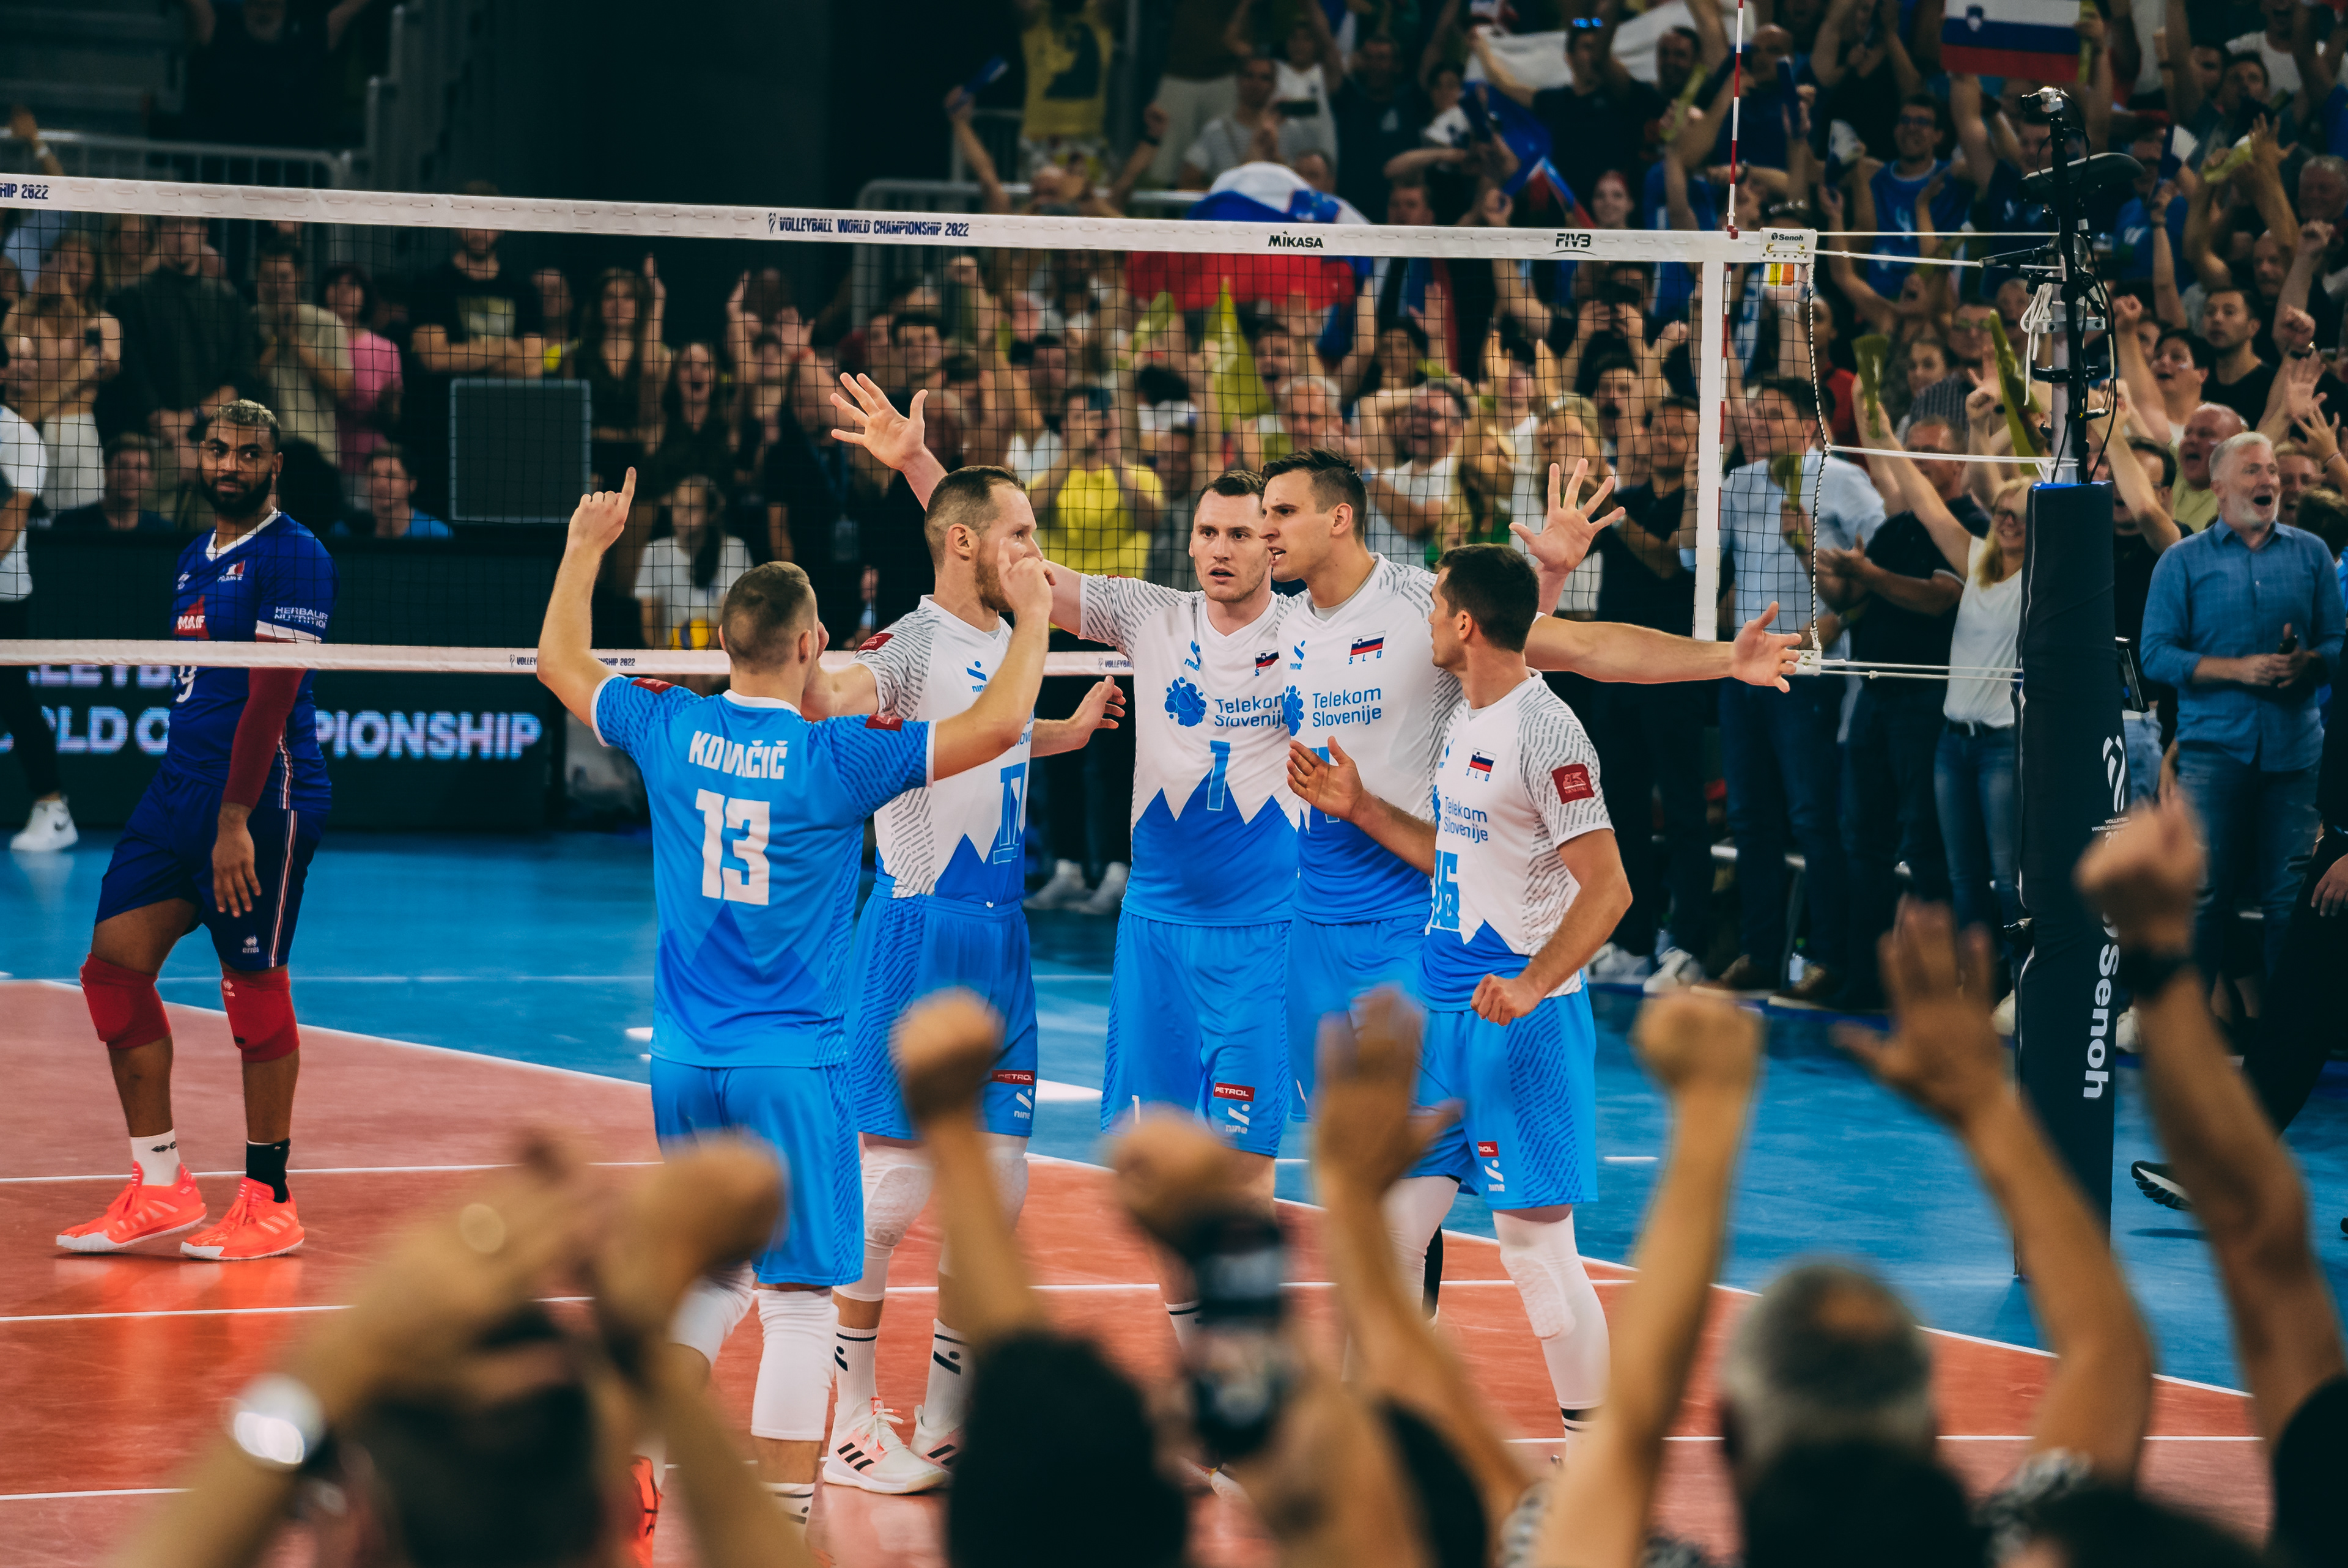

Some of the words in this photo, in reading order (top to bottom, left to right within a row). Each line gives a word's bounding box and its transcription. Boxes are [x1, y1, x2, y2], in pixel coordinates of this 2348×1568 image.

[21, 184, 49, 199] 2022
[780, 217, 833, 232] VOLLEYBALL
[837, 219, 871, 234] WORLD
[874, 220, 942, 235] CHAMPIONSHIP
[945, 223, 969, 237] 2022
[177, 615, 205, 630] MAIF
[517, 657, 537, 665] VOLLEY
[1312, 688, 1381, 709] Telekom
[1313, 705, 1381, 727] Slovenije
[689, 731, 788, 779] KOVAČIČ
[1207, 740, 1230, 811] 1
[1445, 796, 1488, 823] Telekom
[1444, 817, 1488, 844] Slovenije
[695, 789, 770, 905] 13
[2083, 944, 2120, 1099] Senoh
[1215, 1087, 1249, 1097] PETROL
